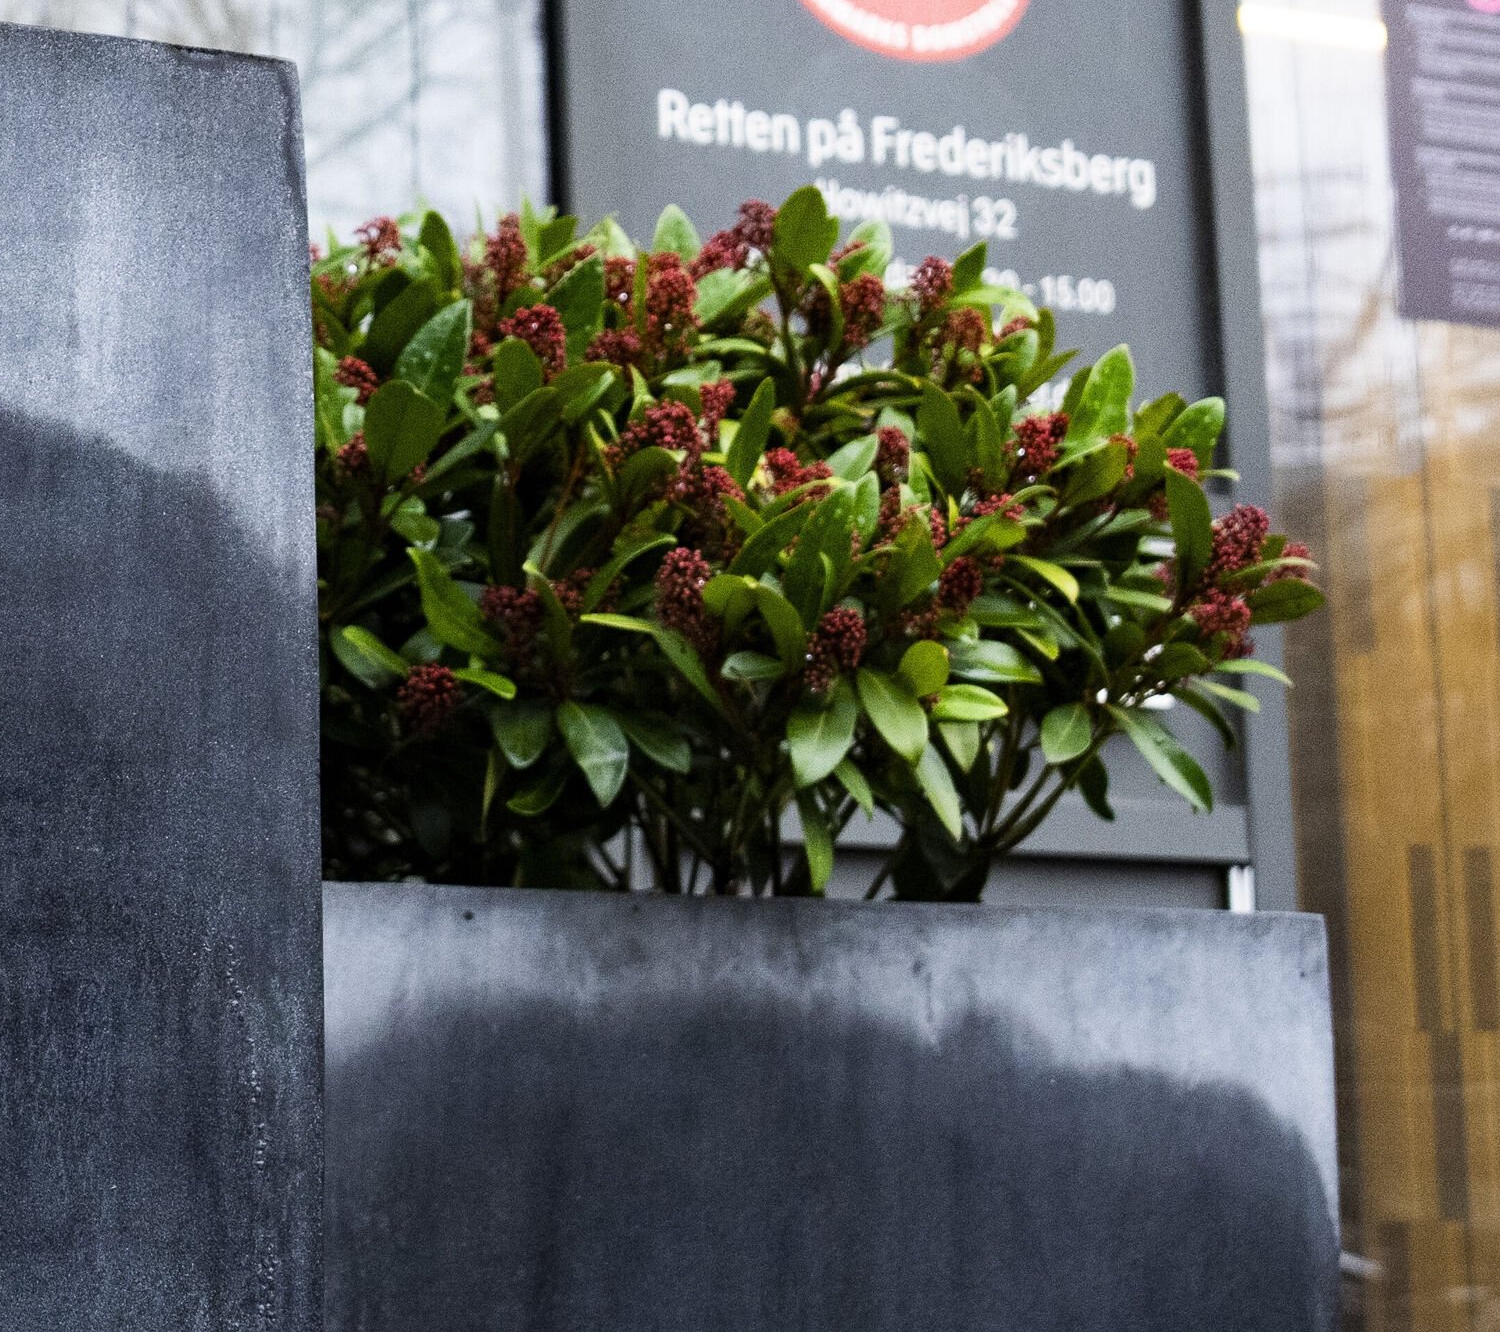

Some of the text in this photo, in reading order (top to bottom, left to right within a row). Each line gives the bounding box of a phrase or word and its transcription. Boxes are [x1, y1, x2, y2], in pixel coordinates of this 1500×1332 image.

[657, 88, 1156, 209] Retten på Frederiksberg
[971, 195, 1018, 240] 32
